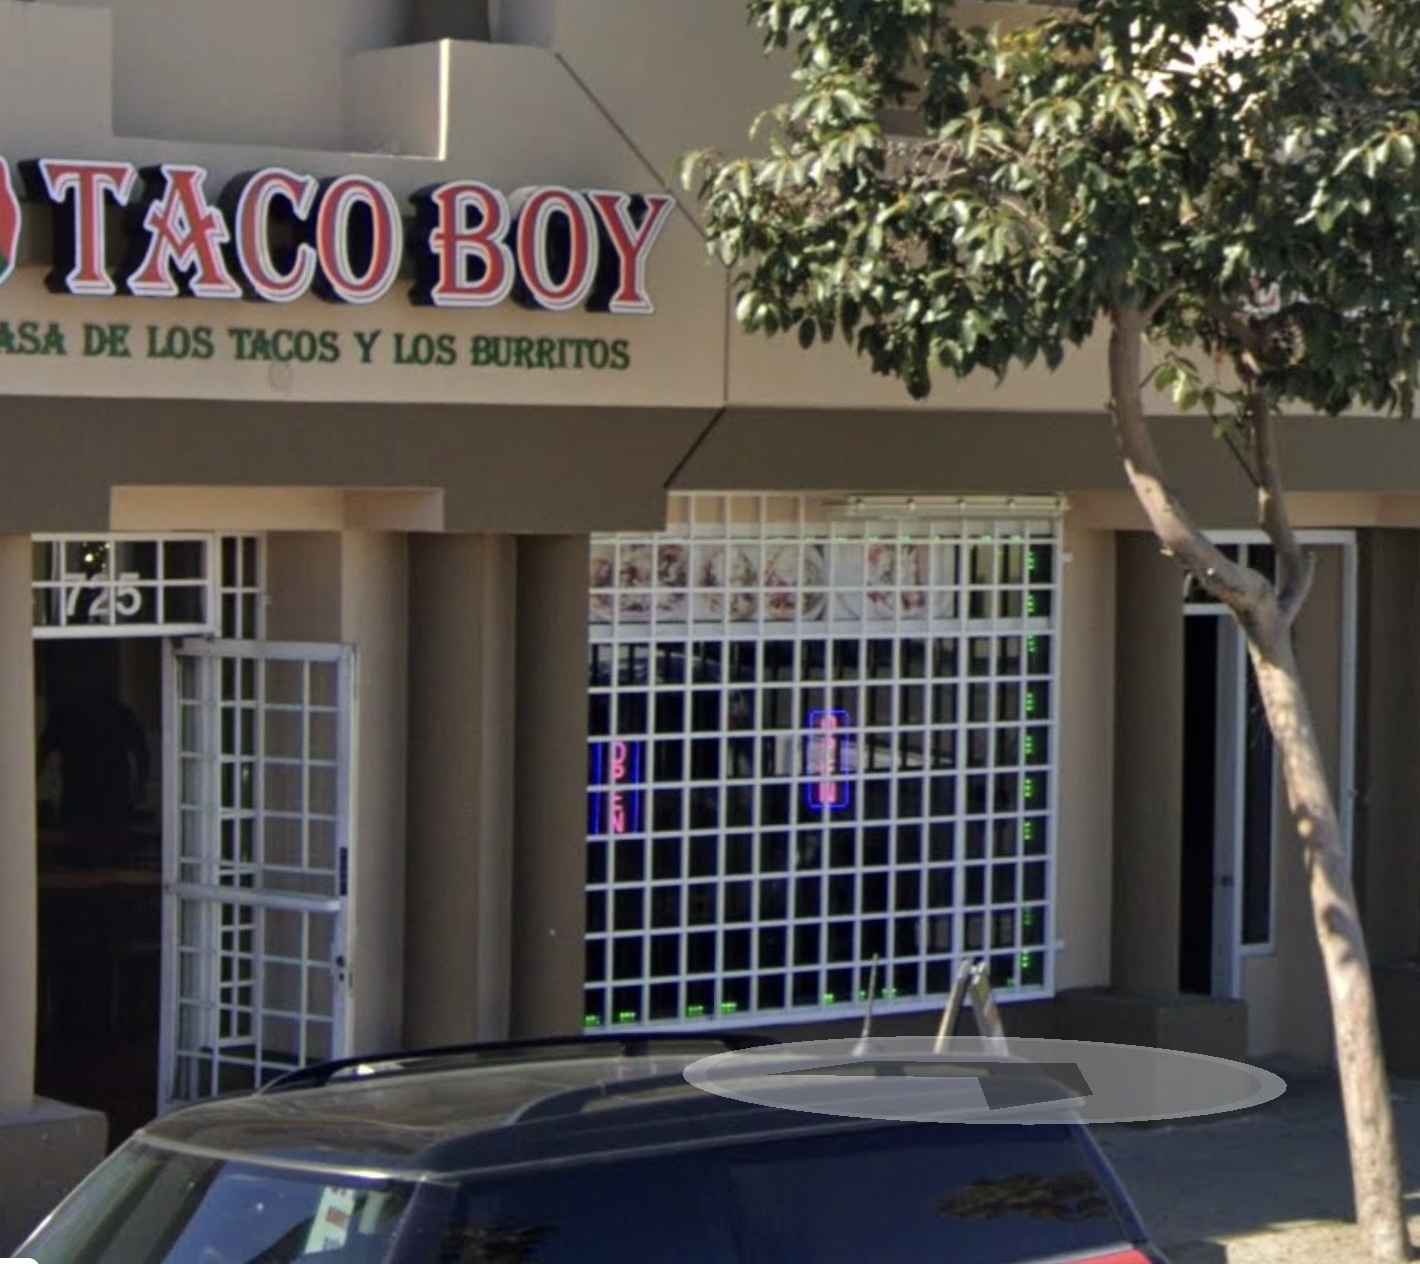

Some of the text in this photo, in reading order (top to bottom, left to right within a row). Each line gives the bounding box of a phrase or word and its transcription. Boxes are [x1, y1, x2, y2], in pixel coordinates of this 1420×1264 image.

[38, 158, 676, 314] TACO BOY
[84, 325, 131, 358] DE
[147, 326, 213, 360] LOS
[230, 329, 340, 363] TACOS
[355, 331, 381, 364] Y
[394, 331, 457, 366] LOS
[471, 333, 630, 371] BURRITOS
[64, 572, 142, 616] 725
